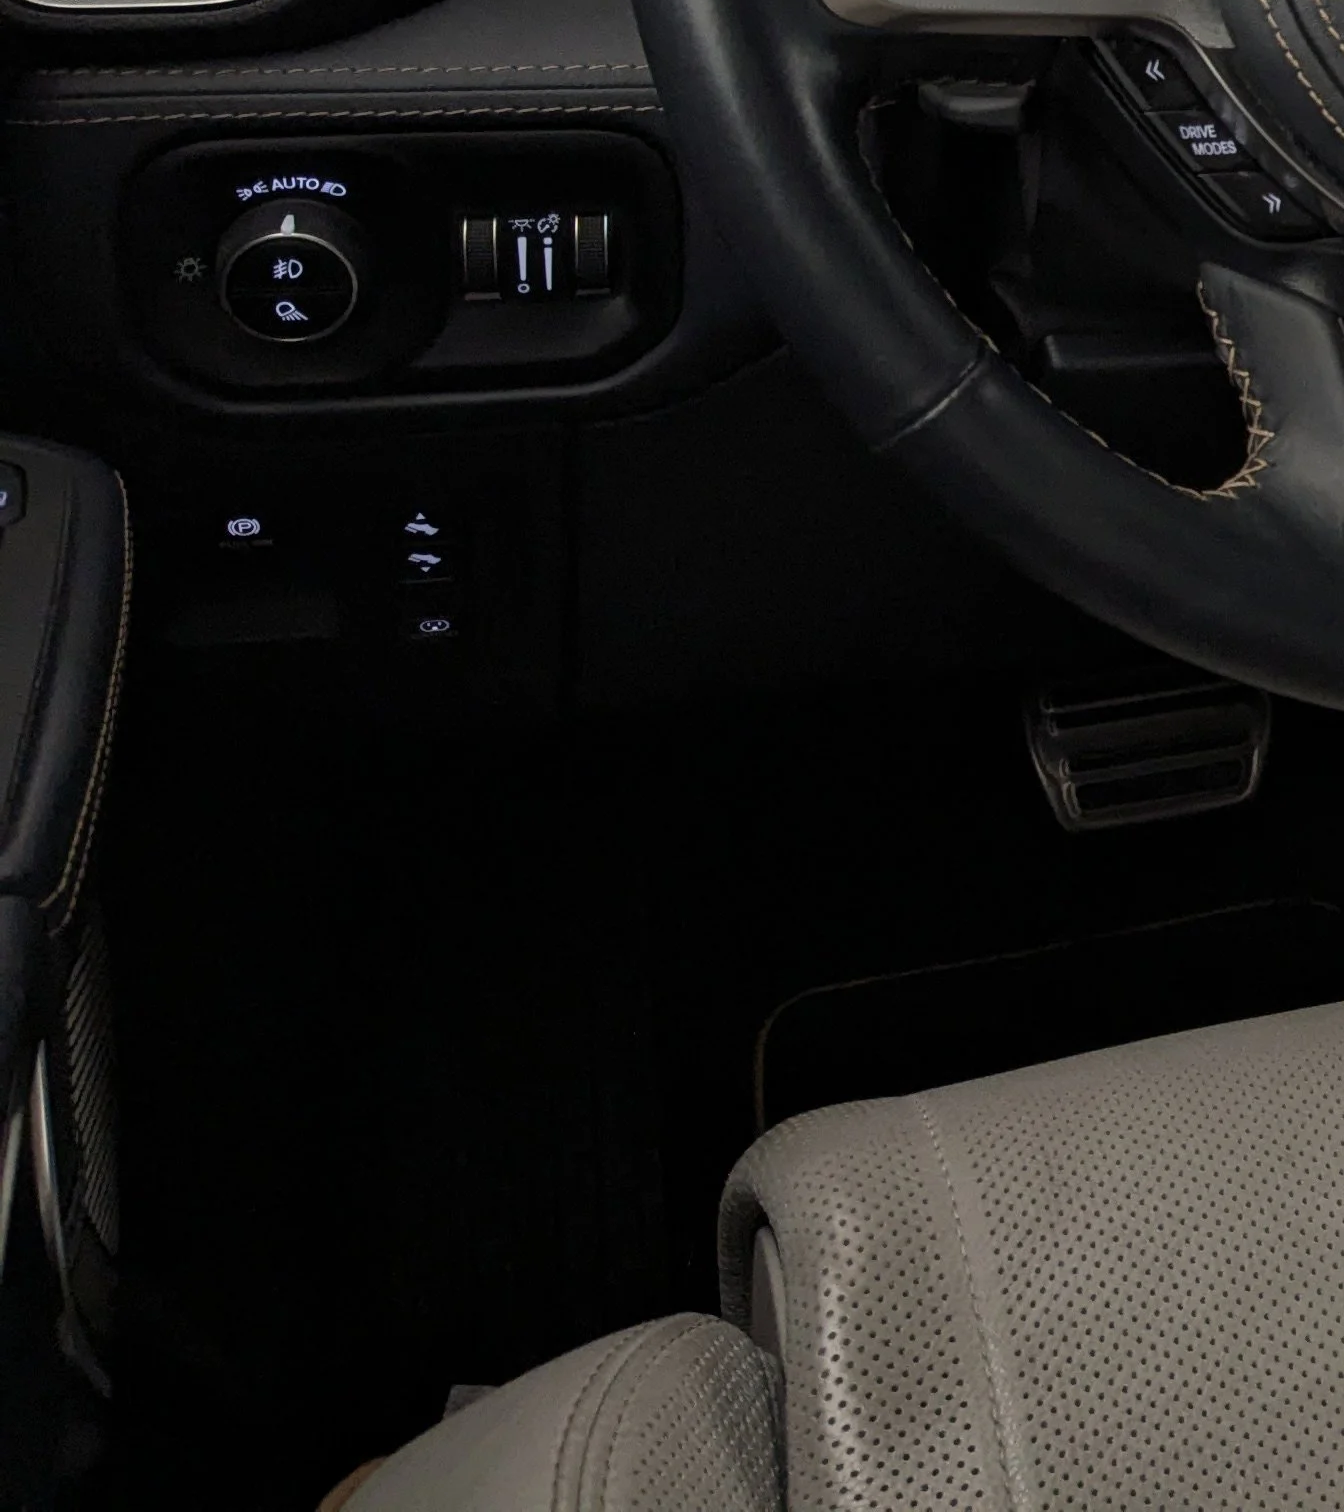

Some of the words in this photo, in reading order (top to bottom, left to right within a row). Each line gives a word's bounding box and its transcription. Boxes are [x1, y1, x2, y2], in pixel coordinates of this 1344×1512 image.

[1178, 124, 1217, 140] DRIVE
[1191, 140, 1237, 156] MODES
[271, 177, 320, 192] AUTO
